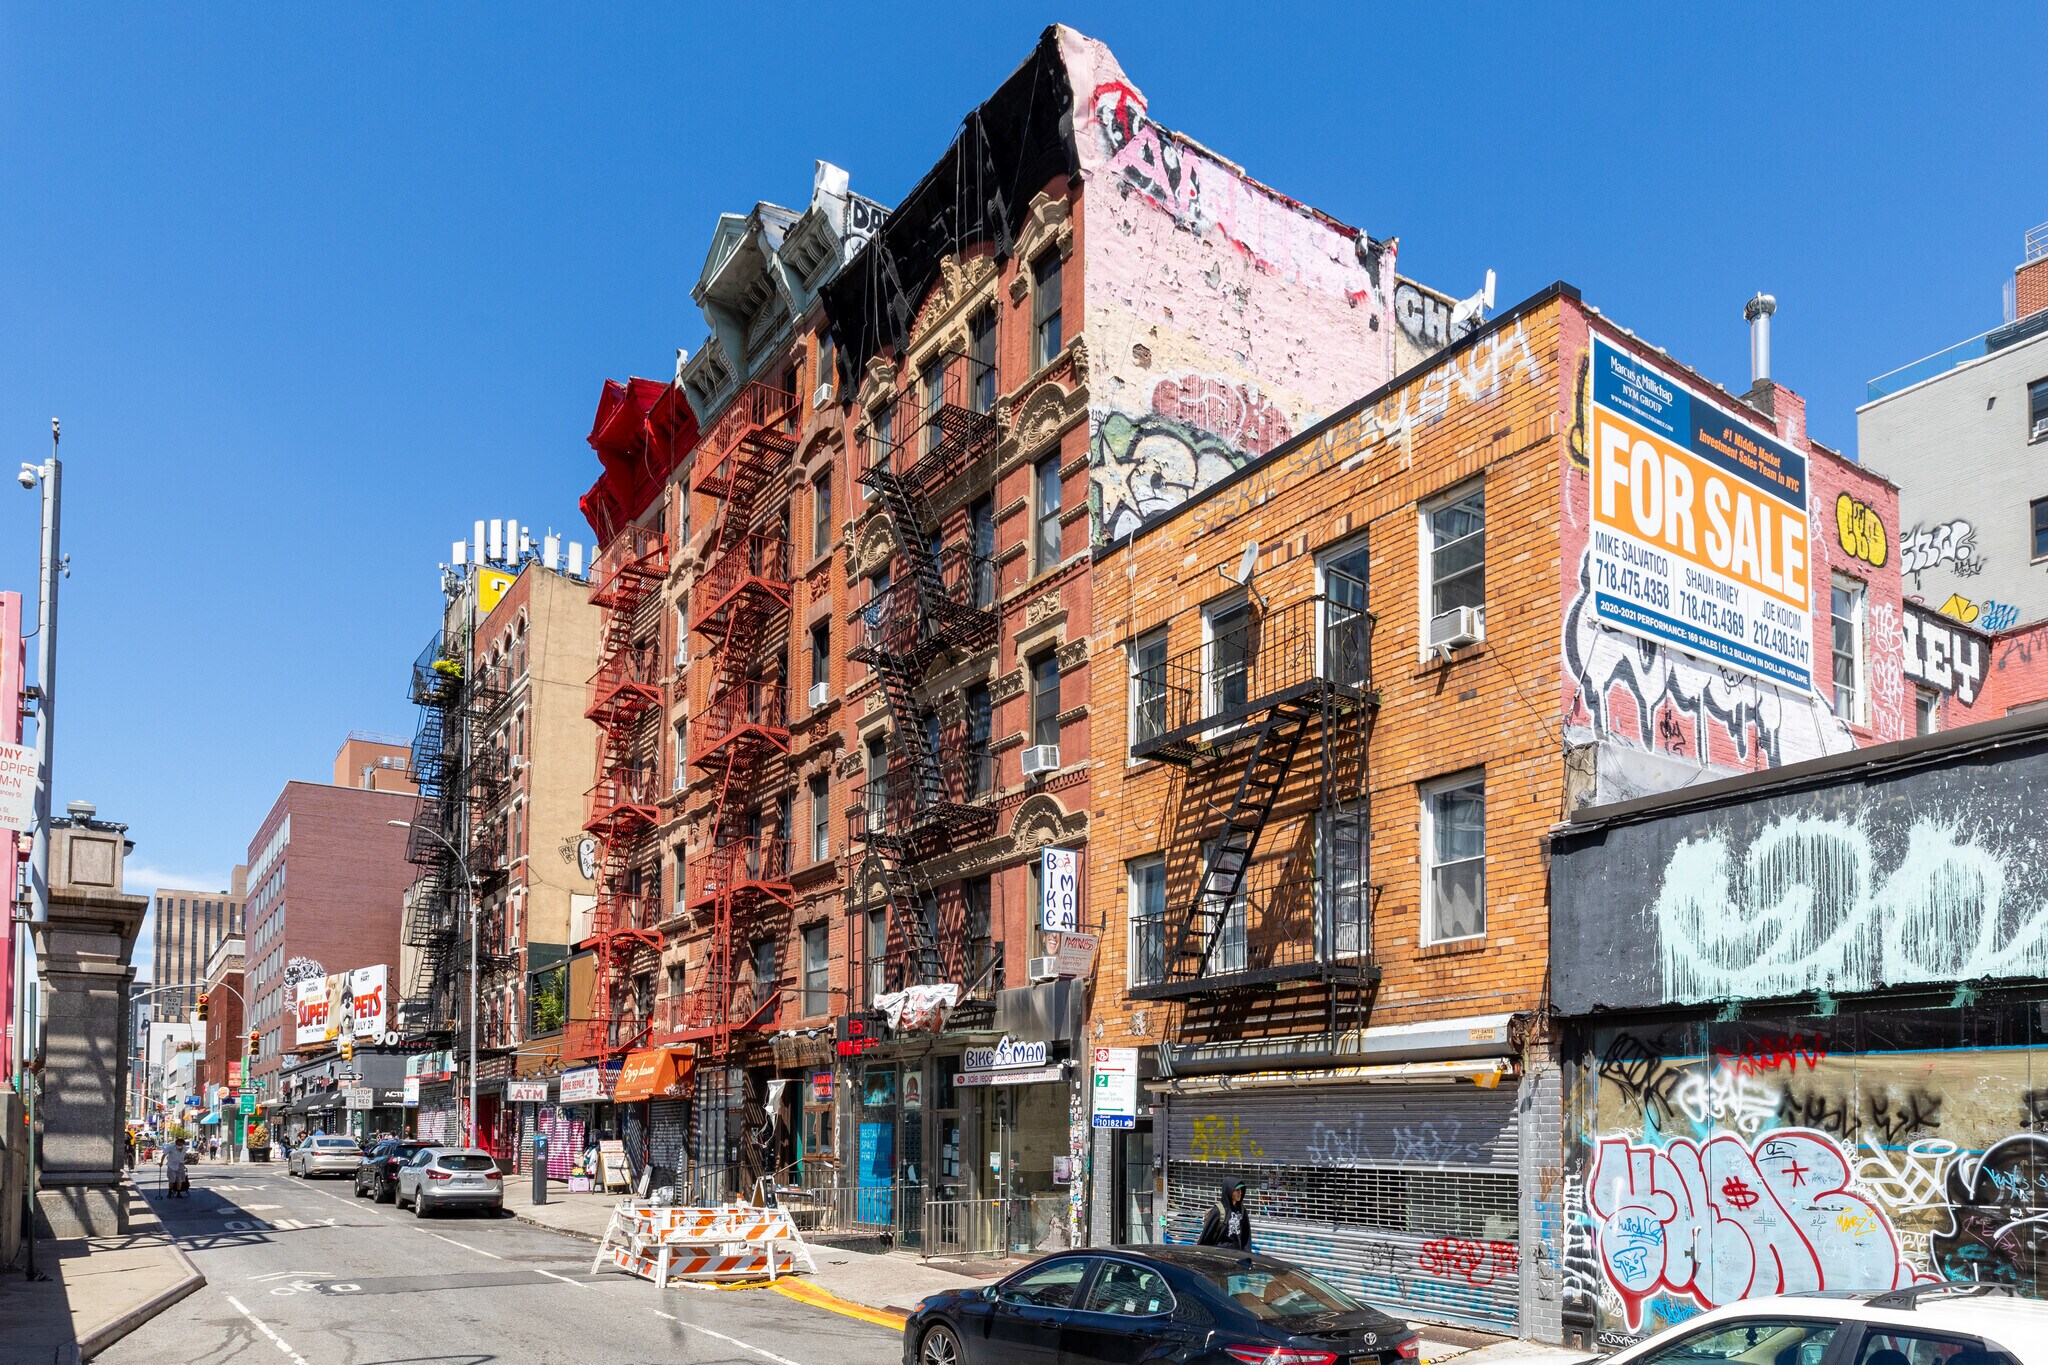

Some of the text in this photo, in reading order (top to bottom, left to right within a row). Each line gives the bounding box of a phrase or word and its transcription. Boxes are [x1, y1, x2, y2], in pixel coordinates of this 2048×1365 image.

[1611, 356, 1673, 403] Marcus & Millichap
[1623, 384, 1662, 413] NYM GROUP
[1699, 429, 1799, 492] Investment Sales Team in NYC
[1723, 428, 1780, 468] #1 Middle Market
[1601, 421, 1697, 555] FOR
[1704, 477, 1804, 603] SALE
[1596, 531, 1667, 577] MIKE SALVATICO
[1596, 558, 1669, 610] 718.475.4358
[1686, 568, 1739, 606] SHAUN RINEY
[1680, 590, 1744, 638] 718.475.4369
[1762, 600, 1801, 632] JOE KOICIM
[1600, 600, 1636, 620] 2020-2021
[1637, 614, 1687, 639] PERFORMANCE:
[1688, 632, 1698, 643] 169
[1699, 635, 1717, 651] SALES
[1734, 648, 1757, 665] BILLION
[1757, 657, 1764, 667] IN
[1765, 660, 1786, 676] DOLLAR
[1787, 668, 1808, 685] VOLUME
[1753, 620, 1809, 664] 212.430.5147
[4, 815, 19, 823] FEET
[1046, 853, 1057, 926] BIKE
[1060, 874, 1073, 929] MAN
[298, 1000, 329, 1028] SUPER
[354, 985, 382, 1019] PETS
[355, 1021, 367, 1030] JULY
[372, 1031, 399, 1045] 90
[966, 1045, 1044, 1066] BIKE MAN
[980, 1072, 995, 1084] repair
[997, 1070, 1028, 1082] accessories
[1099, 1076, 1105, 1086] 2
[862, 1141, 876, 1150] SPACE
[862, 1152, 870, 1160] FOR
[224, 1217, 335, 1231] ONLY
